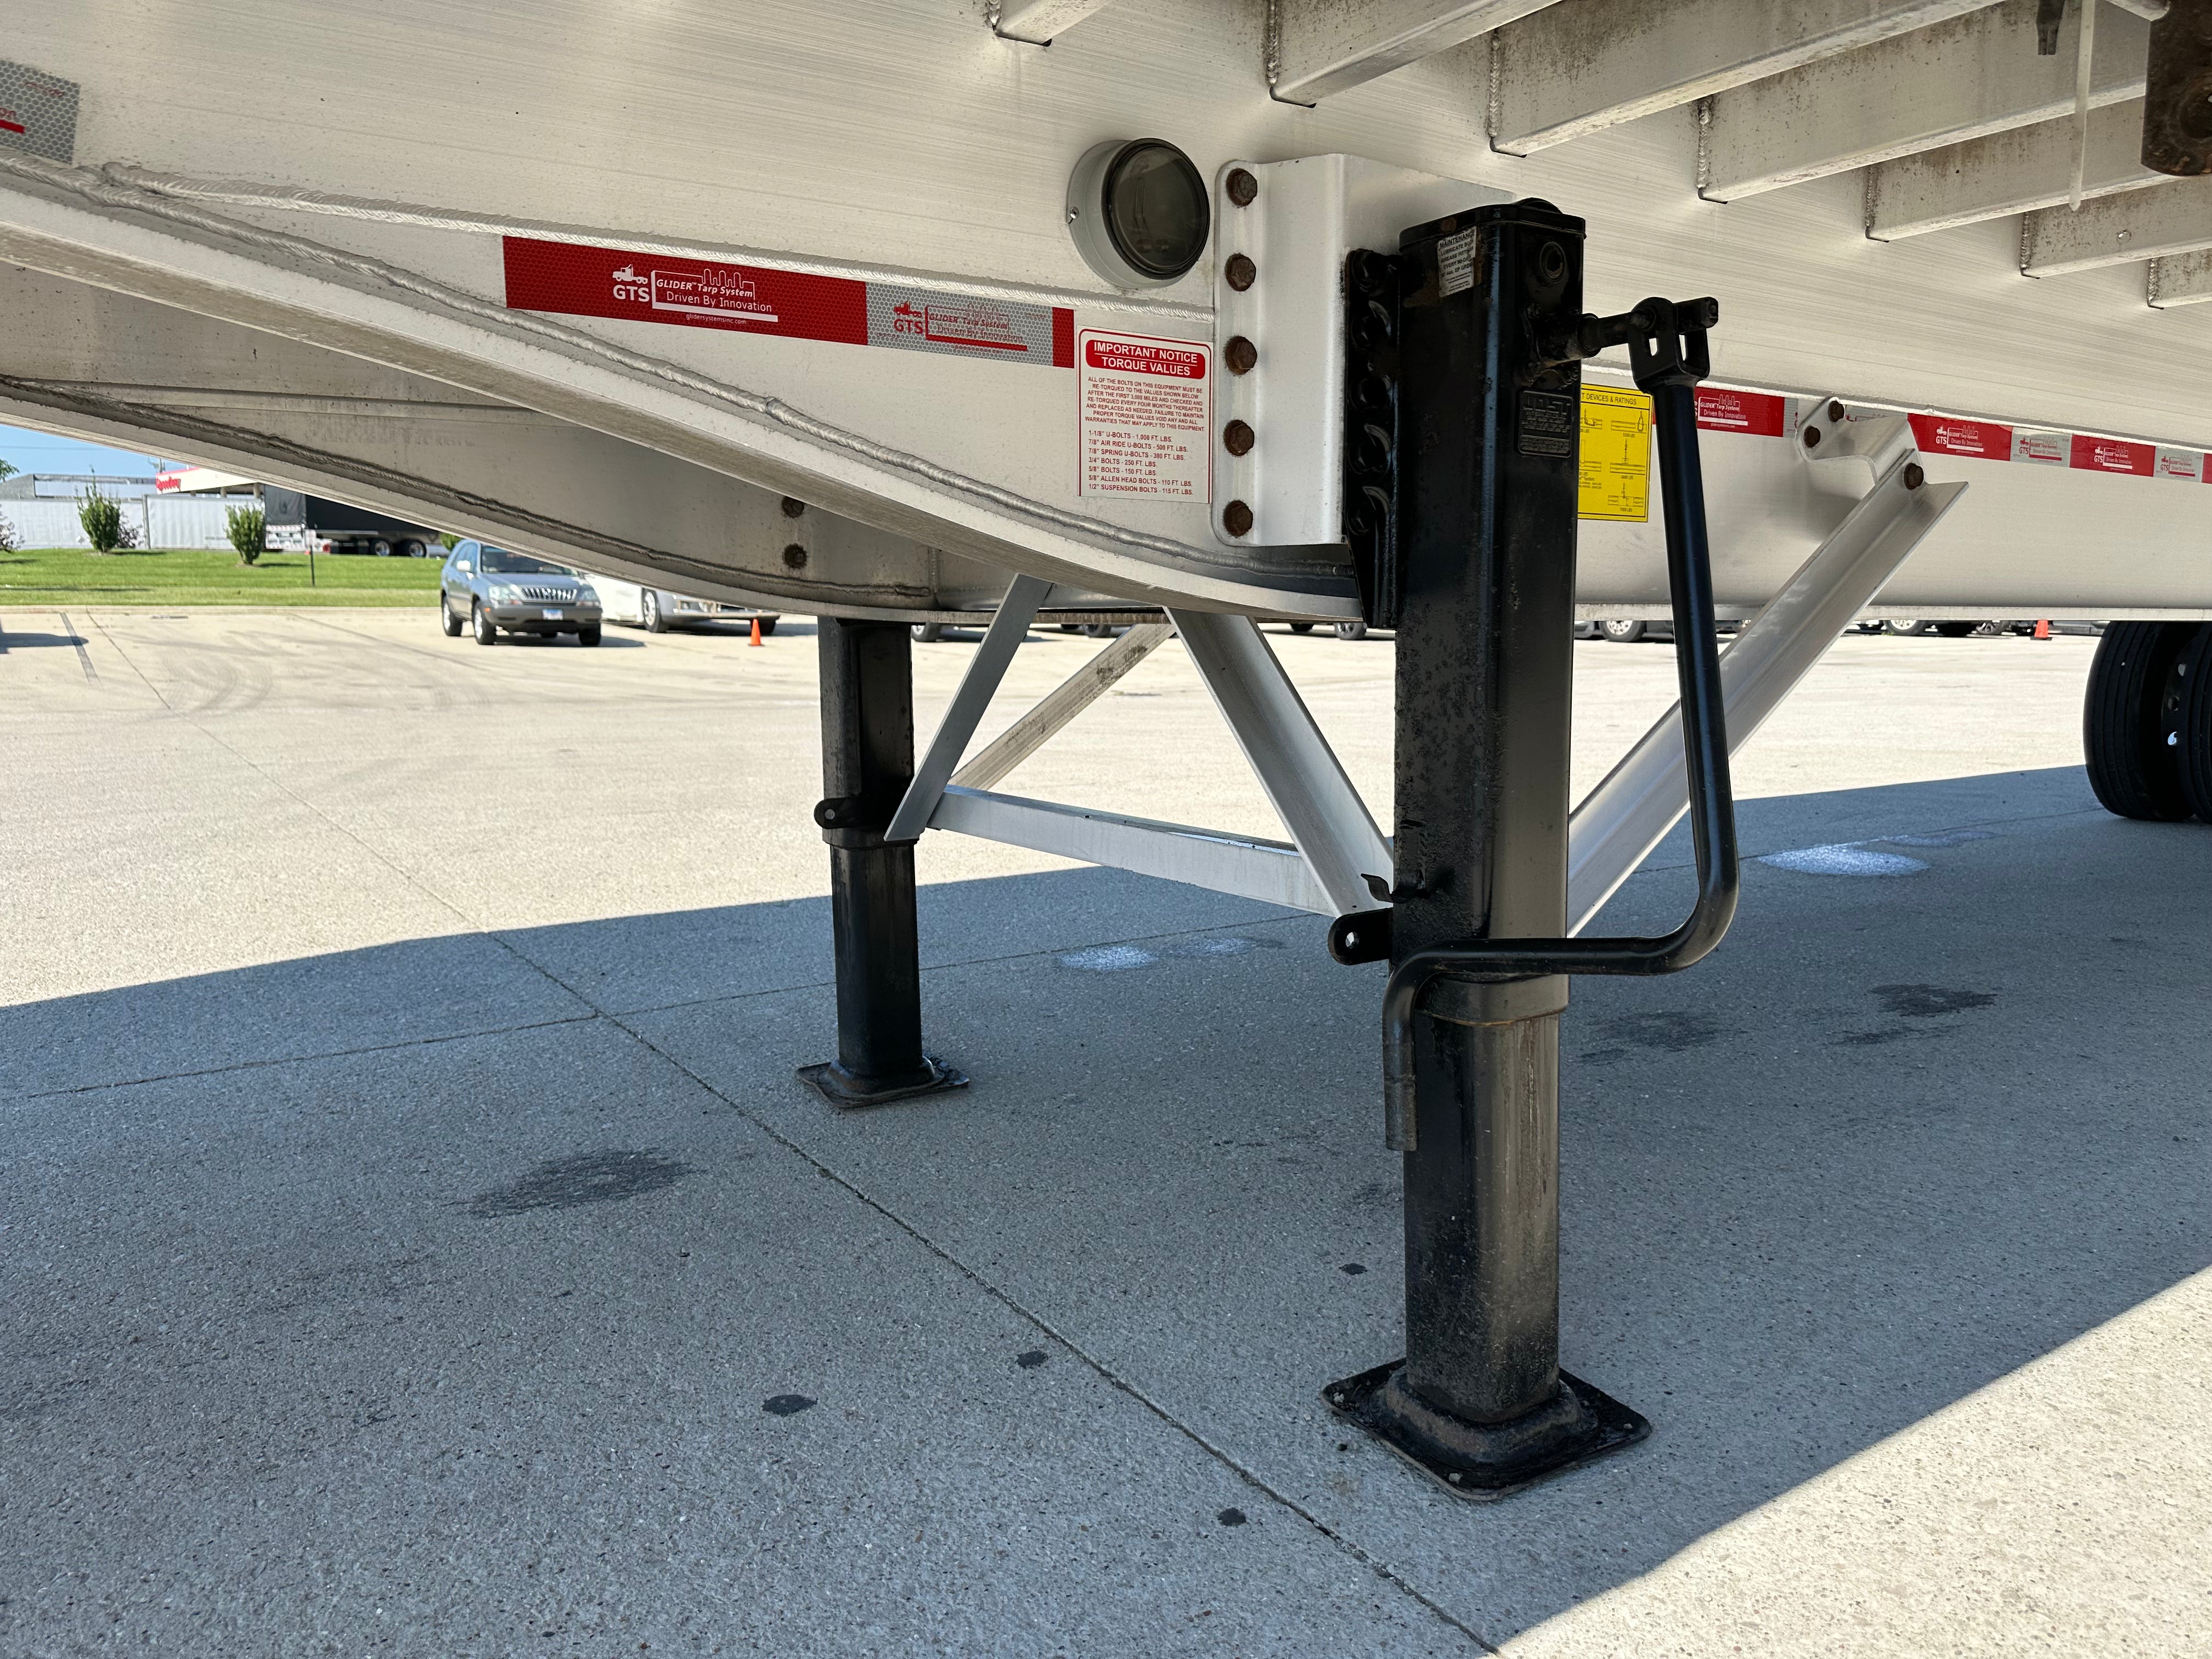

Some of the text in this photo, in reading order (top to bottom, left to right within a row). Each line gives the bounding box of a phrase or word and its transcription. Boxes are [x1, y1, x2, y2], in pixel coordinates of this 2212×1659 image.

[613, 285, 650, 302] GTS
[697, 284, 718, 294] Tarp
[720, 286, 753, 297] System
[667, 291, 772, 312] Driven By Innovation
[894, 319, 923, 334] GTS
[981, 319, 1008, 329] System
[938, 324, 1023, 342] Driven By Innovation
[1094, 341, 1198, 363] IMPORTANT NOTICE
[1102, 357, 1190, 376] TORQUE VALUES
[1092, 383, 1124, 392] RE-TORQUED
[1587, 393, 1609, 402] DEVICES
[1615, 396, 1637, 405] RATINGS
[1936, 436, 1946, 444] GTS
[2094, 455, 2103, 463] GTS
